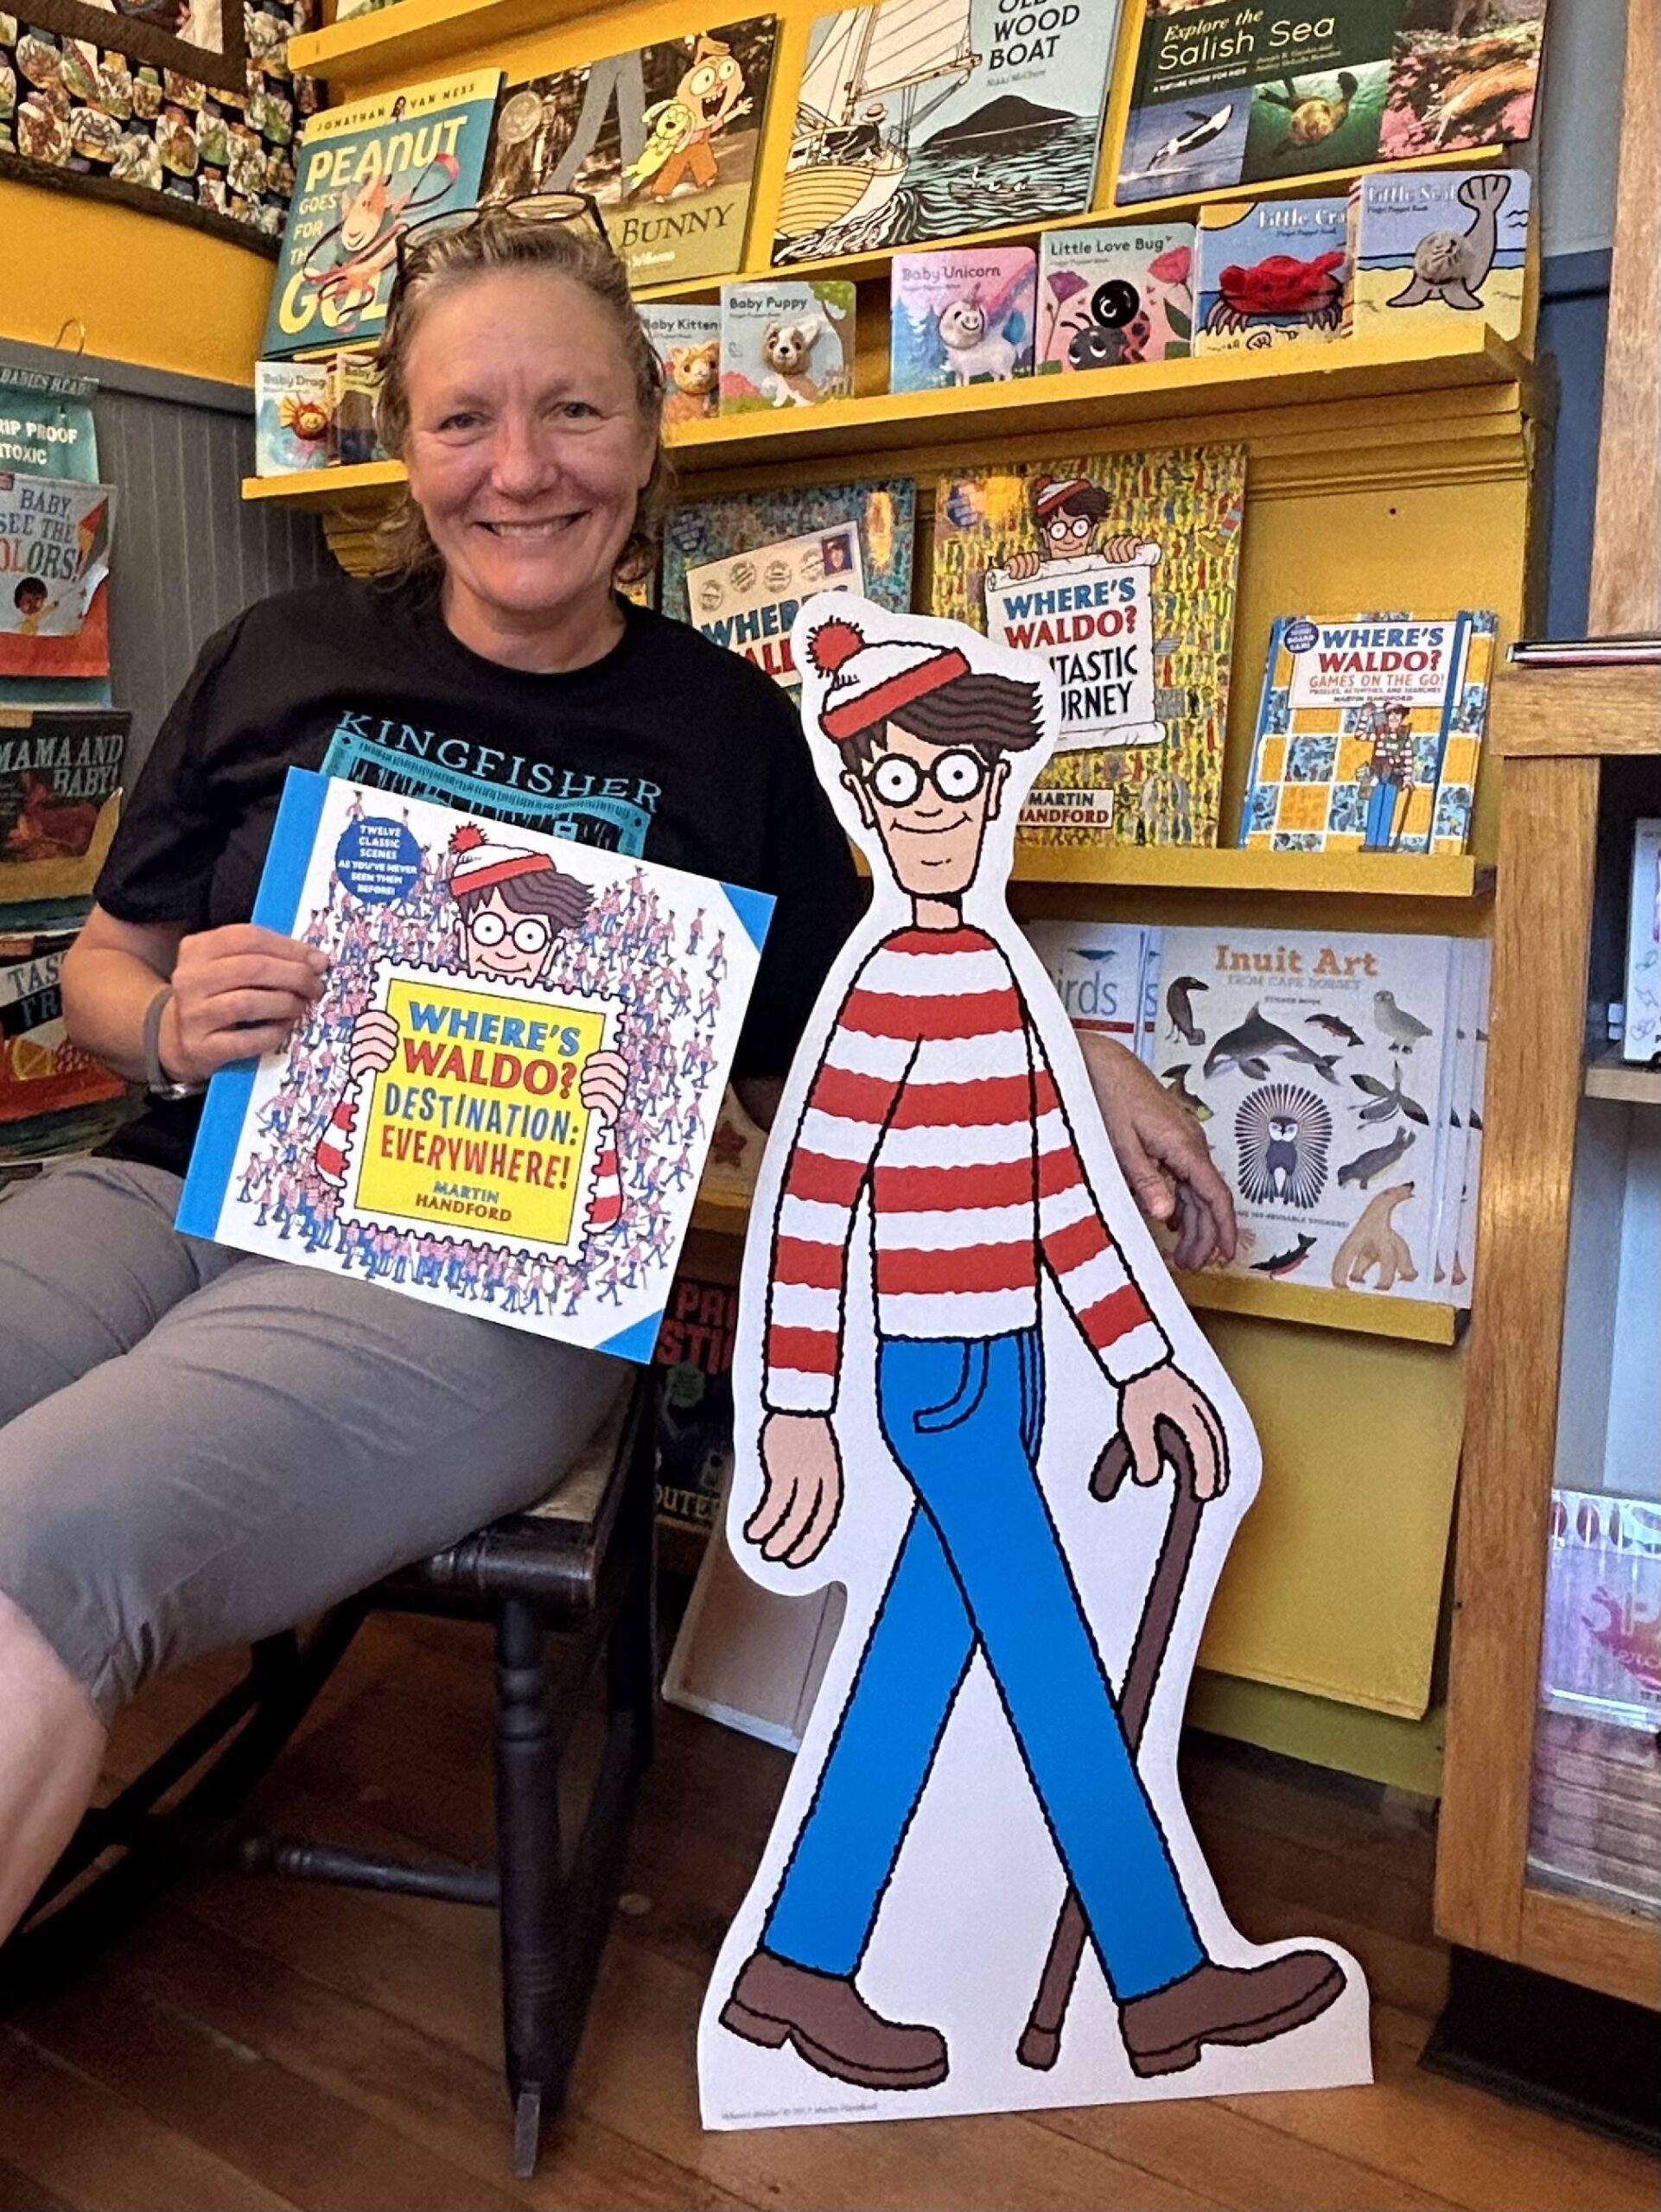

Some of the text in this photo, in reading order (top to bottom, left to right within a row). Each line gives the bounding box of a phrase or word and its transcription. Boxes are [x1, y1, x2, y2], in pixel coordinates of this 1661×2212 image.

[994, 4, 1080, 43] WOOD
[1163, 9, 1264, 43] Explore the
[989, 35, 1060, 71] BOAT
[1158, 29, 1255, 70] Salish
[1269, 17, 1335, 47] Sea
[315, 83, 476, 132] JONATHAN VAN NESS
[299, 193, 337, 215] GOES
[293, 220, 324, 242] FOR
[620, 202, 735, 248] BUNNY
[1051, 238, 1164, 256] Little Love Bug
[902, 266, 1002, 283] Baby Unicorn
[729, 296, 808, 312] Baby Puppy
[678, 319, 716, 331] Kitten
[1, 368, 49, 390] BABIES
[263, 373, 294, 388] Baby
[25, 422, 79, 444] PROOF
[20, 486, 73, 520] BABY,
[42, 518, 76, 543] THE
[1003, 576, 1136, 620] WHERE'S
[1003, 605, 1137, 650] WALDO?
[1322, 627, 1444, 649] WHERE'S
[1049, 644, 1138, 686] TASTIC
[1318, 649, 1442, 673] WALDO?
[1309, 673, 1445, 689] GAMES ON THE GO!
[76, 734, 124, 766] AND
[337, 710, 663, 814] KINGFISHER
[1028, 792, 1095, 806] MARTIN
[359, 836, 401, 849] CLASSIC
[360, 824, 401, 838] TWELVE
[360, 848, 398, 860] SCENES
[338, 859, 351, 869] AS
[386, 864, 417, 874] NEVER
[351, 871, 403, 885] SEEN THEM
[357, 884, 396, 896] BEFORE!
[1215, 944, 1378, 976] Inuit Art
[1227, 974, 1362, 991] FROM CAPE DORSET
[409, 1001, 581, 1057] WHERE'S
[403, 1037, 577, 1100] WALDO?
[383, 1082, 579, 1146] DESTINATION:
[381, 1124, 571, 1190] EVERYWHERE!
[432, 1180, 500, 1205] MARTIN
[416, 1193, 512, 1223] HANDFORD
